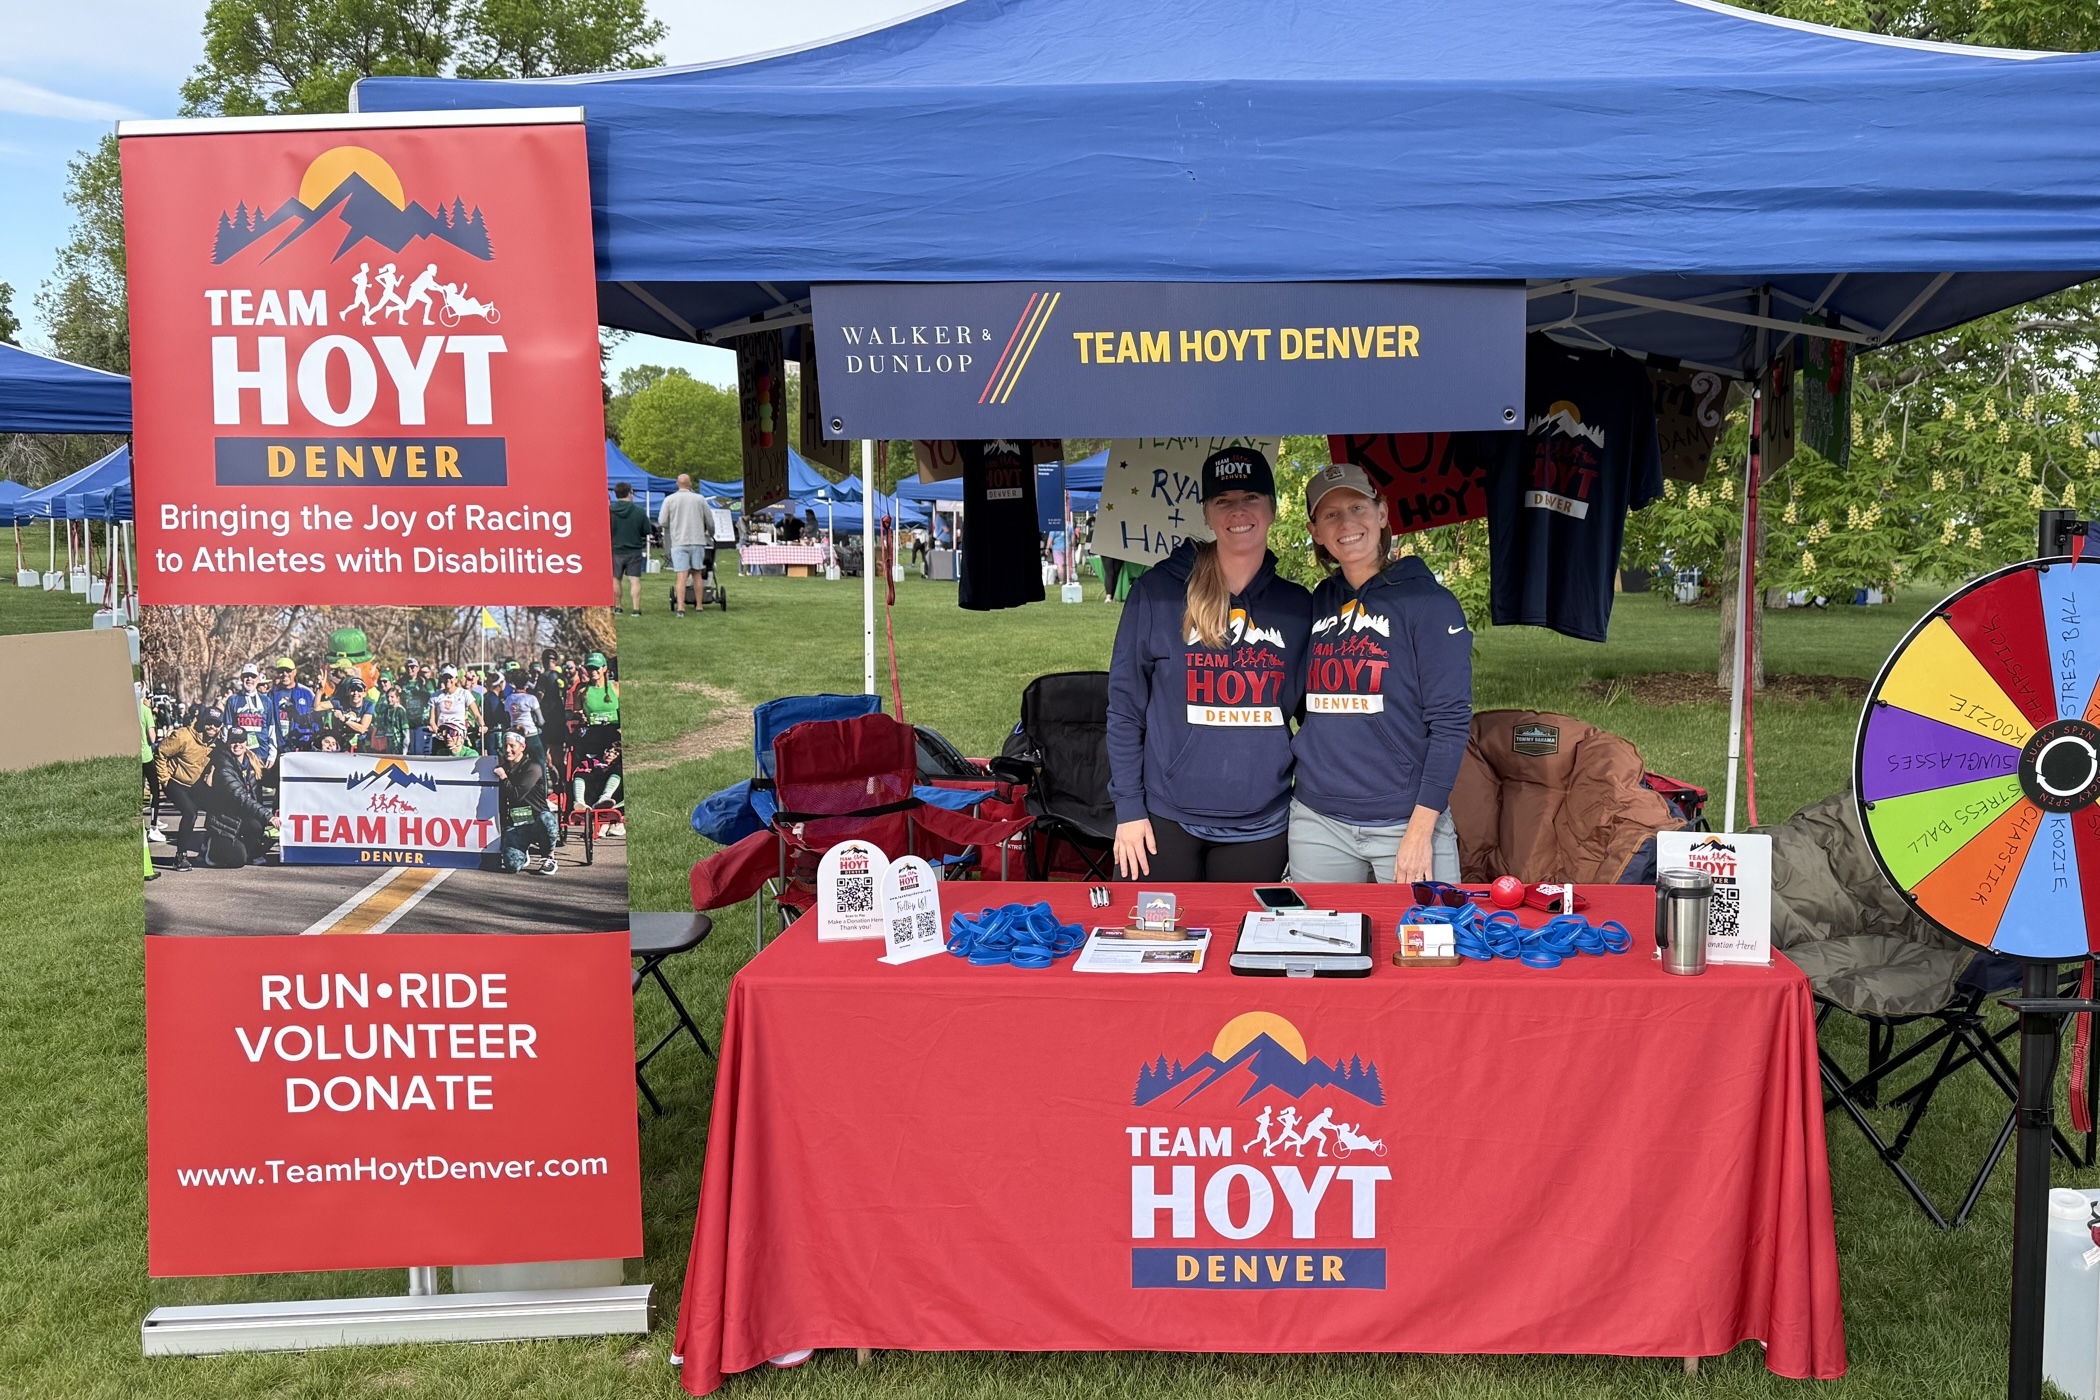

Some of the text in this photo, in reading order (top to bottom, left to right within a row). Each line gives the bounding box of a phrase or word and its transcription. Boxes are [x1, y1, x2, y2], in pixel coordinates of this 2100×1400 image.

[204, 289, 327, 327] TEAM
[841, 326, 992, 345] WALKER &
[1073, 324, 1420, 364] TEAM HOYT DENVER
[846, 354, 973, 374] DUNLOP
[210, 334, 508, 428] HOYT
[1659, 423, 1711, 454] DAM
[267, 445, 462, 478] DENVER
[1215, 457, 1230, 467] TEAM
[1215, 462, 1252, 478] HOYT
[1151, 469, 1201, 506] RYA
[1399, 475, 1488, 528] HOY
[160, 503, 572, 538] Bringing the Joy of Racing
[156, 546, 583, 575] to Athletes with Disabilities
[1185, 653, 1229, 668] TEAM
[1982, 613, 2047, 723] CHAPSTICK
[2061, 591, 2081, 716] STRESS BALL
[1187, 669, 1285, 705] HOYT
[1307, 657, 1390, 692] HOYT
[1206, 709, 1273, 723] DENVER
[1314, 697, 1369, 710] DENVER
[1950, 694, 2027, 743] KOOZIE
[2027, 726, 2095, 764] LUCKY SPIN
[1888, 752, 2015, 772] SUNGLASSES
[2039, 792, 2070, 806] SPIN
[288, 815, 493, 848] TEAM HOYT
[1907, 783, 2020, 853] STRESS BALL
[360, 850, 424, 865] DENVER
[840, 860, 869, 870] HOYT
[1971, 806, 2038, 905] CHAPSTICK
[2050, 818, 2068, 892] KOOZIE
[899, 875, 918, 886] HOYT
[1708, 940, 1757, 950] onation Here!
[235, 1024, 538, 1062] VOLUNTEER
[286, 1075, 494, 1113] DONATE
[1125, 1127, 1232, 1157] TEAM
[177, 1155, 608, 1187] www.TeamHoytDenver.com
[1131, 1164, 1392, 1240] HOYT
[1176, 1255, 1345, 1282] DENVER
